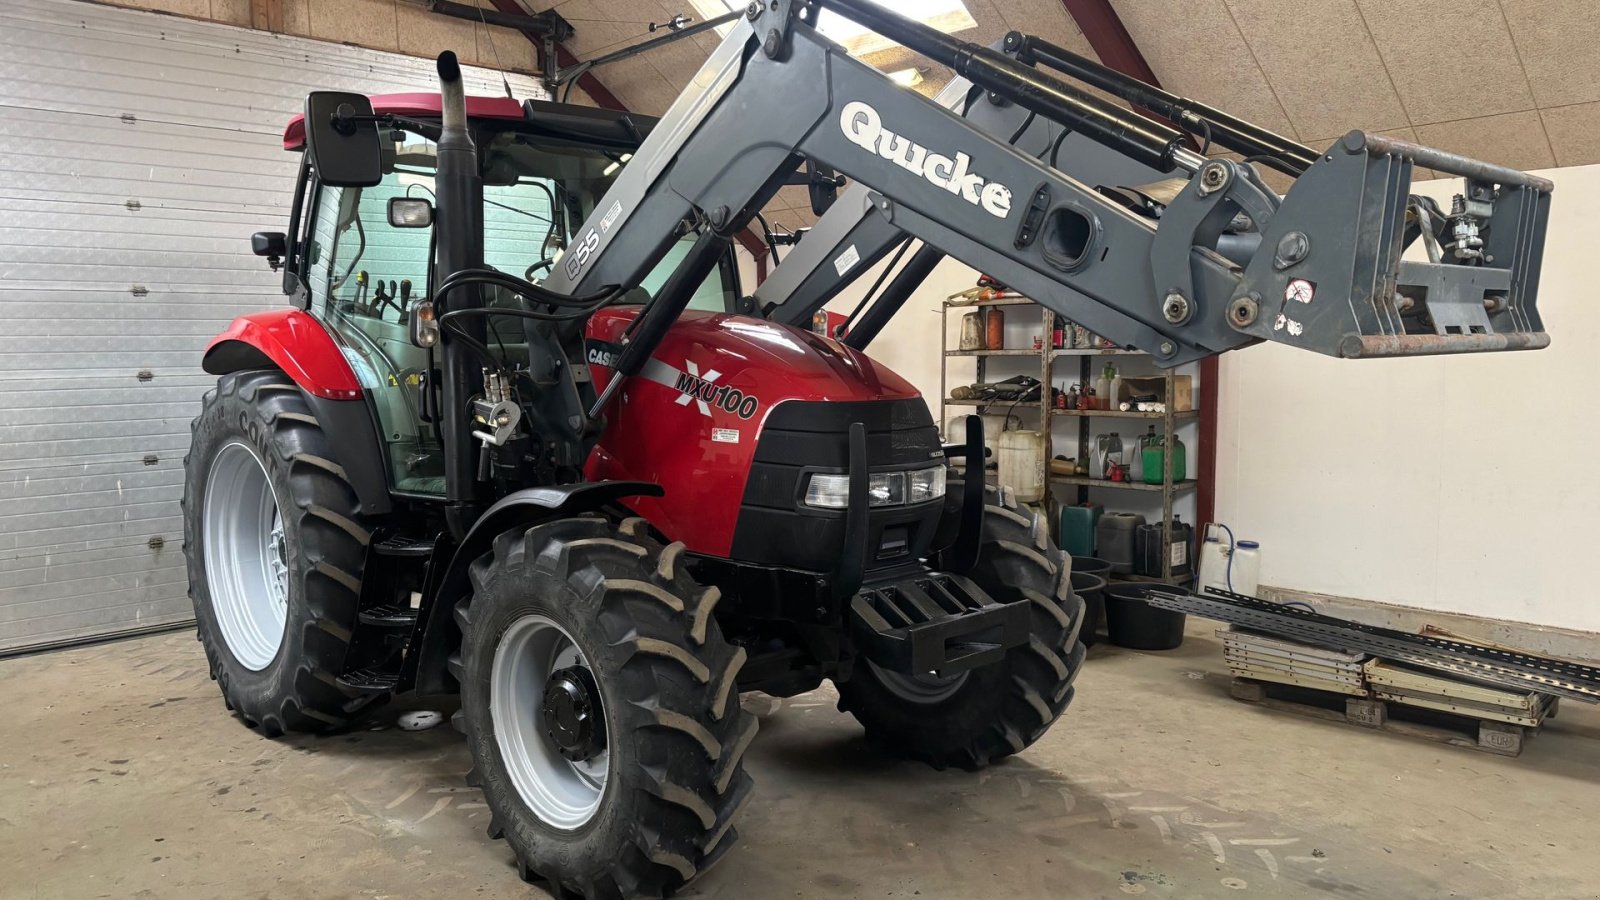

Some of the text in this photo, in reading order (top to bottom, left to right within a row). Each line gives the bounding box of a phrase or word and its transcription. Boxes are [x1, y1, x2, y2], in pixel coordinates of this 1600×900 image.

[840, 101, 1013, 219] Quicke
[565, 227, 600, 281] Q55
[674, 372, 759, 420] MXU100
